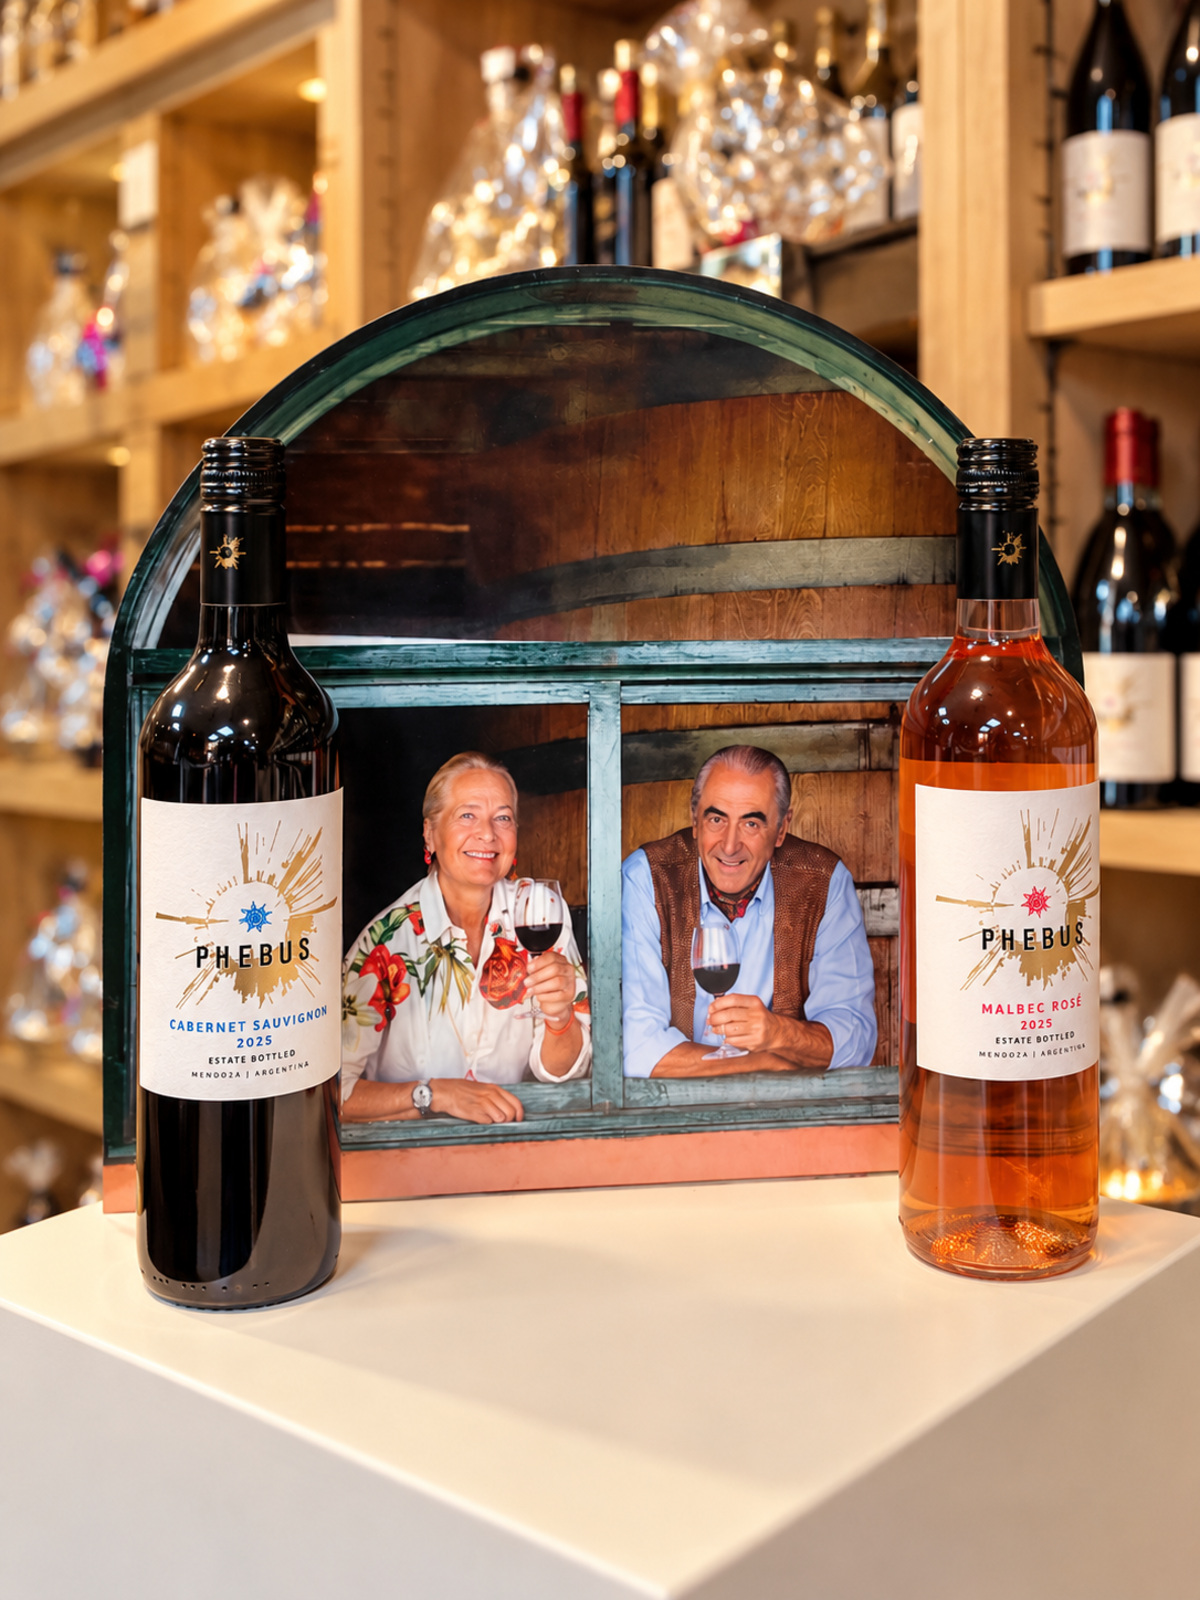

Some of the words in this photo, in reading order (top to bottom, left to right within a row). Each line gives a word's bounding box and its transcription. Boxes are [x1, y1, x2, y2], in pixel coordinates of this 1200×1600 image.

[982, 921, 1083, 951] PHEBUS
[196, 937, 310, 969] PHEBUS
[981, 1003, 1045, 1015] MALBEC
[1051, 993, 1082, 1012] ROSÉ
[169, 1018, 246, 1033] CABERNET
[253, 1005, 328, 1031] SAUVIGNON
[1020, 1018, 1053, 1031] 2025
[236, 1035, 273, 1049] 2025
[995, 1036, 1032, 1045] ESTATE
[1036, 1030, 1075, 1044] BOTTLED
[208, 1055, 246, 1065] ESTATE
[251, 1049, 296, 1063] BOTTLED
[254, 1060, 310, 1077] ARGENTINA
